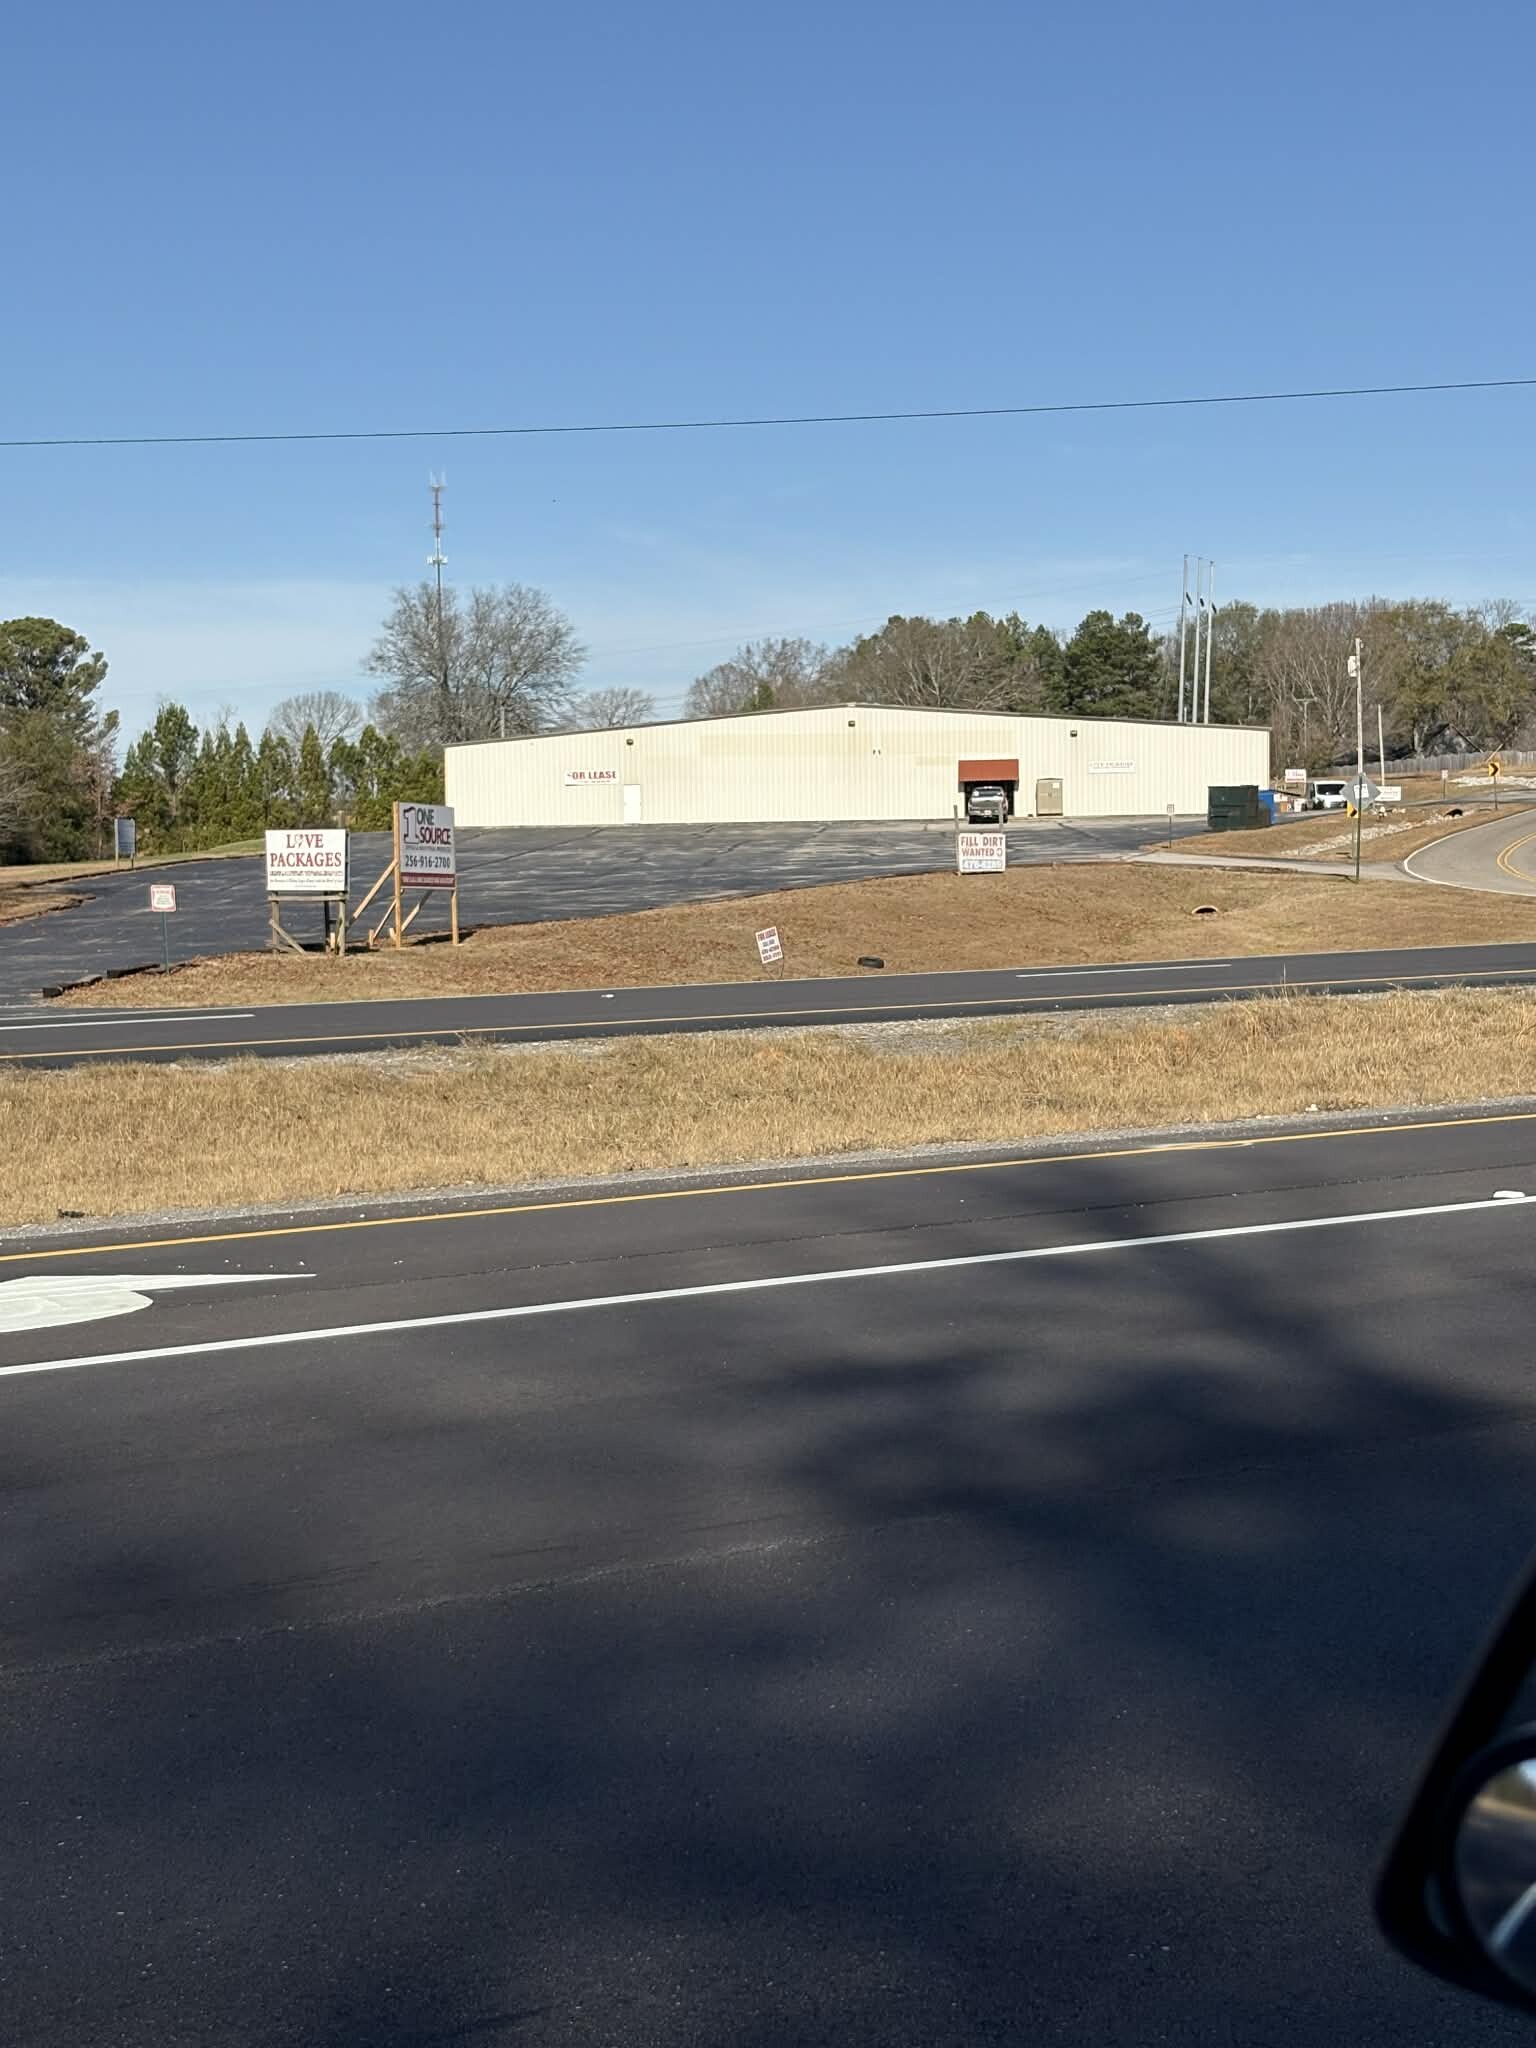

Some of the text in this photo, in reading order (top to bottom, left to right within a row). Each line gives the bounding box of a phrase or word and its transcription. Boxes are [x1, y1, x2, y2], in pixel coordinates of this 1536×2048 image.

[416, 808, 434, 825] ONE
[420, 827, 451, 845] SOURCE
[961, 836, 1004, 847] FILL DIRT
[270, 852, 342, 867] PACKAGES
[961, 847, 995, 857] WANTED
